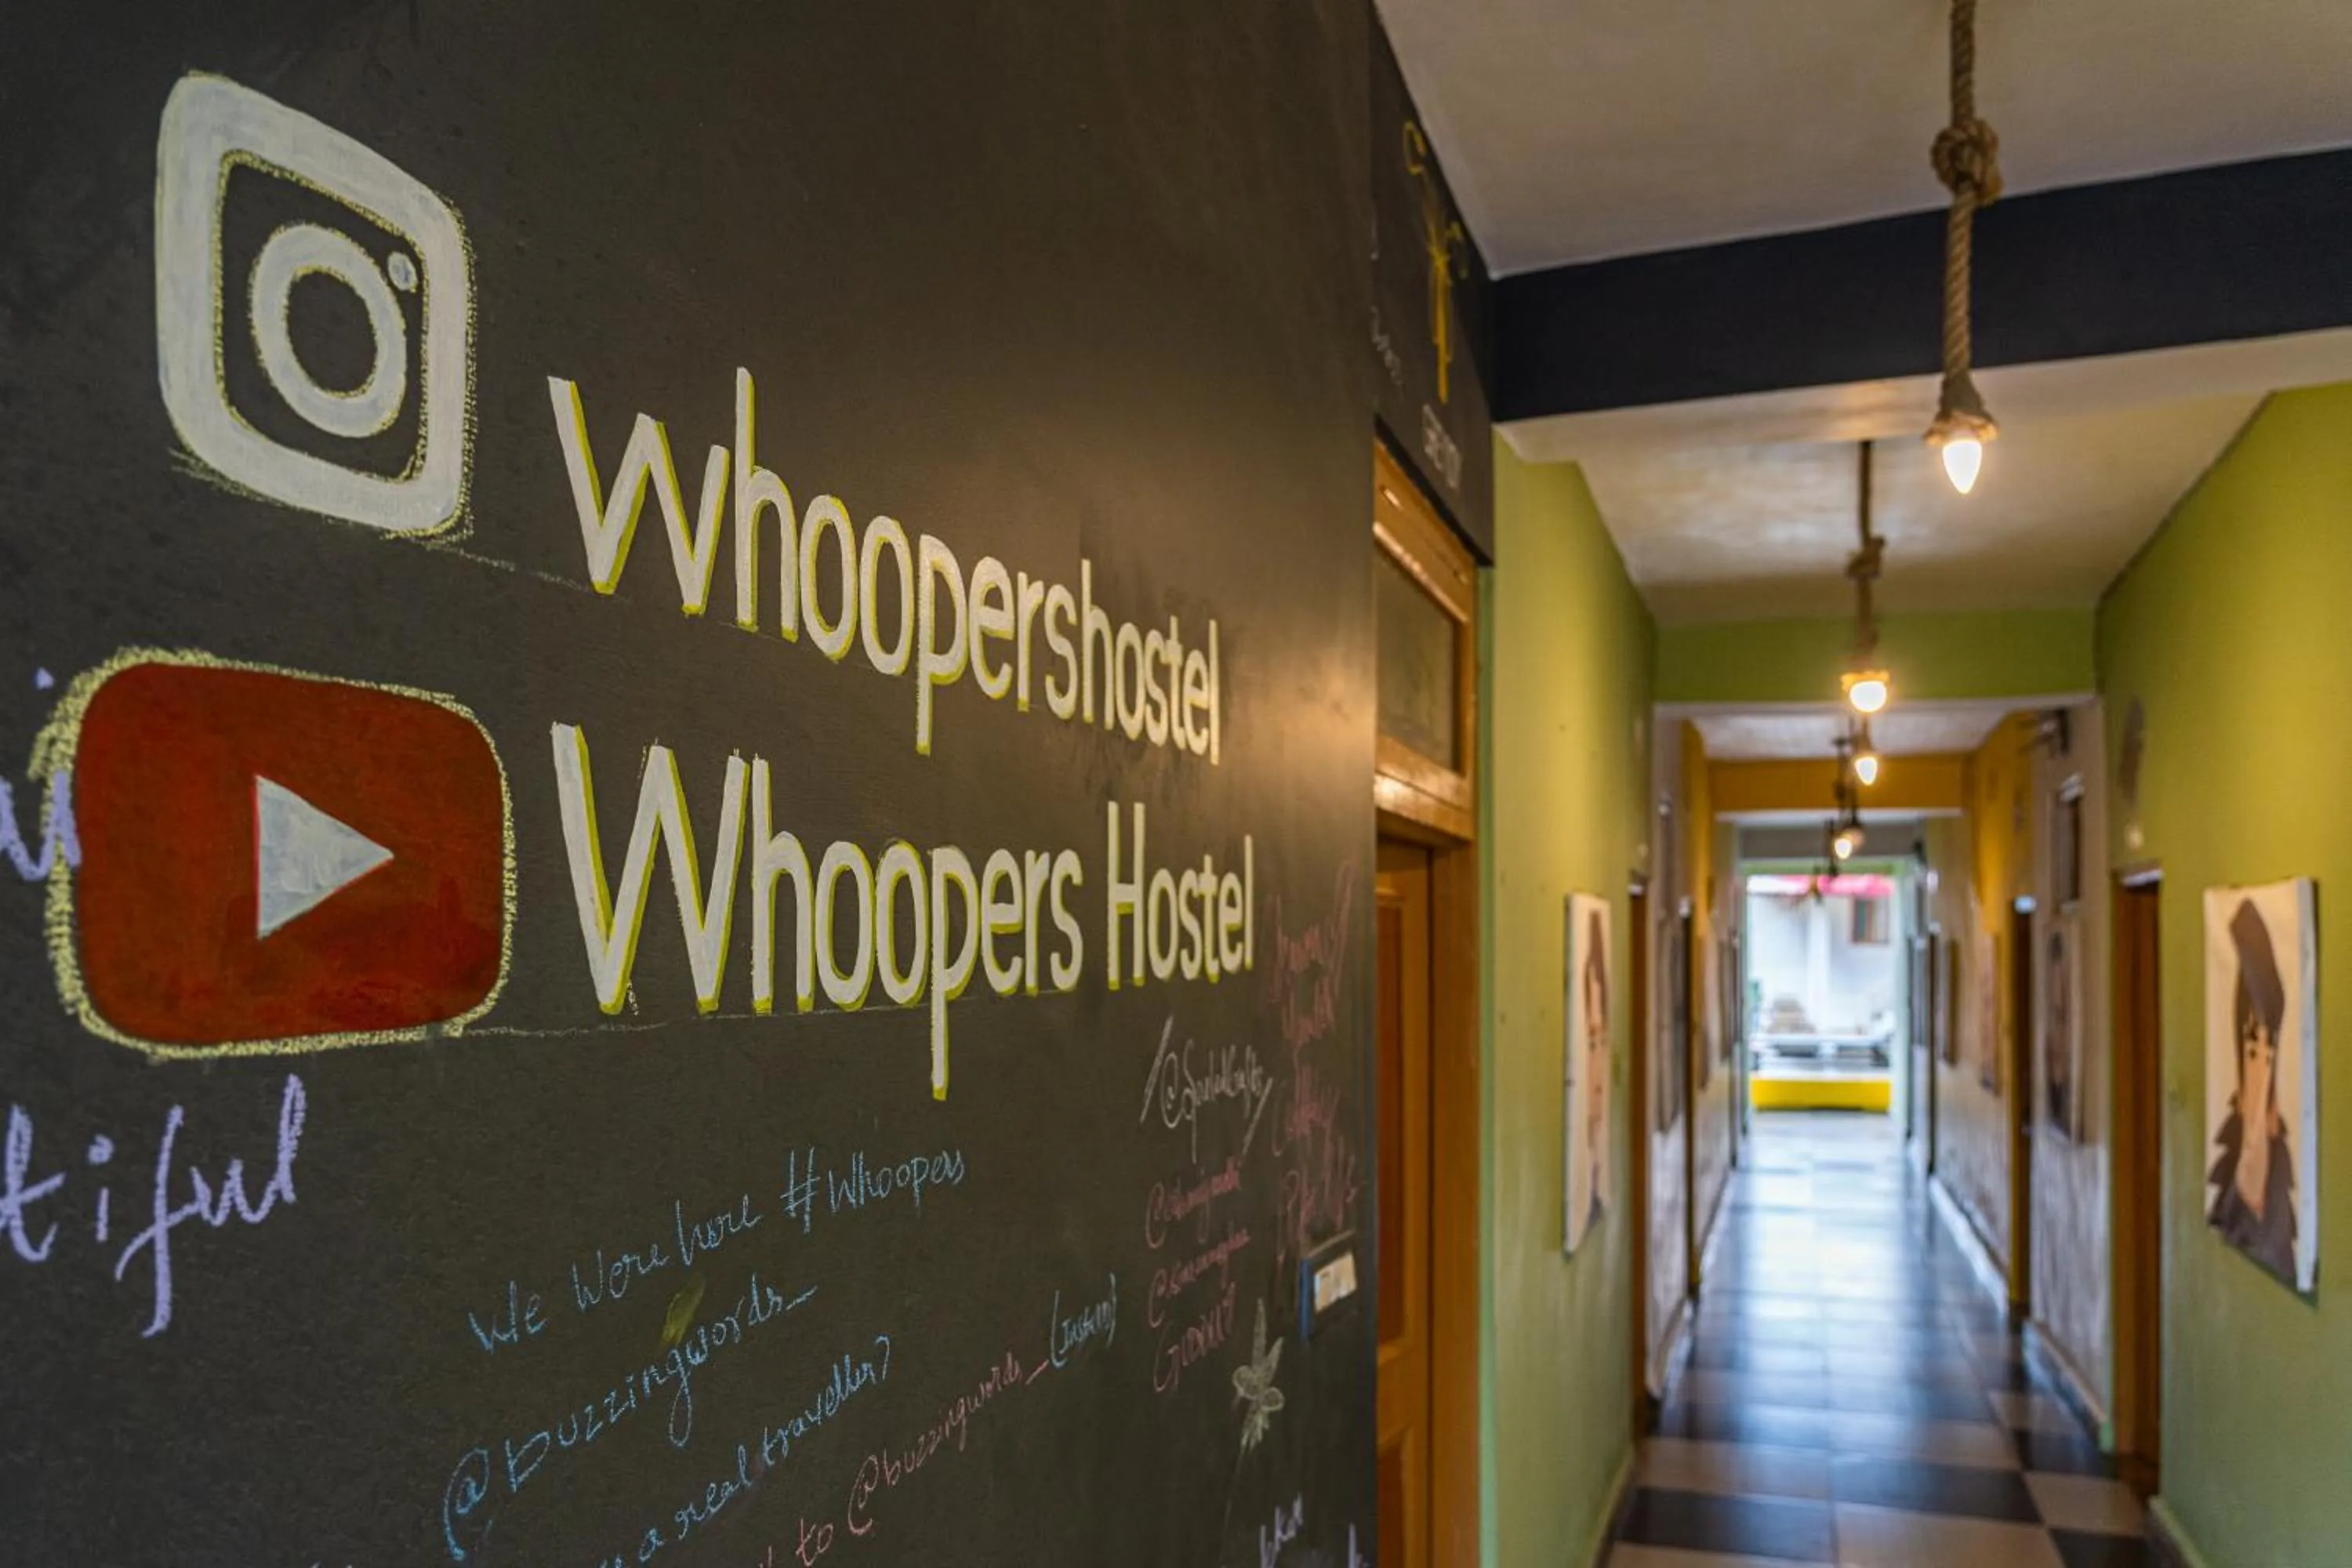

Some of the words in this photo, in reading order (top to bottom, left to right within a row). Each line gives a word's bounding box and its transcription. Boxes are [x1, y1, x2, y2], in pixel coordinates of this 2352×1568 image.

[550, 720, 1084, 1100] Whoopers
[1106, 801, 1253, 990] Hostel
[469, 1280, 547, 1353] We
